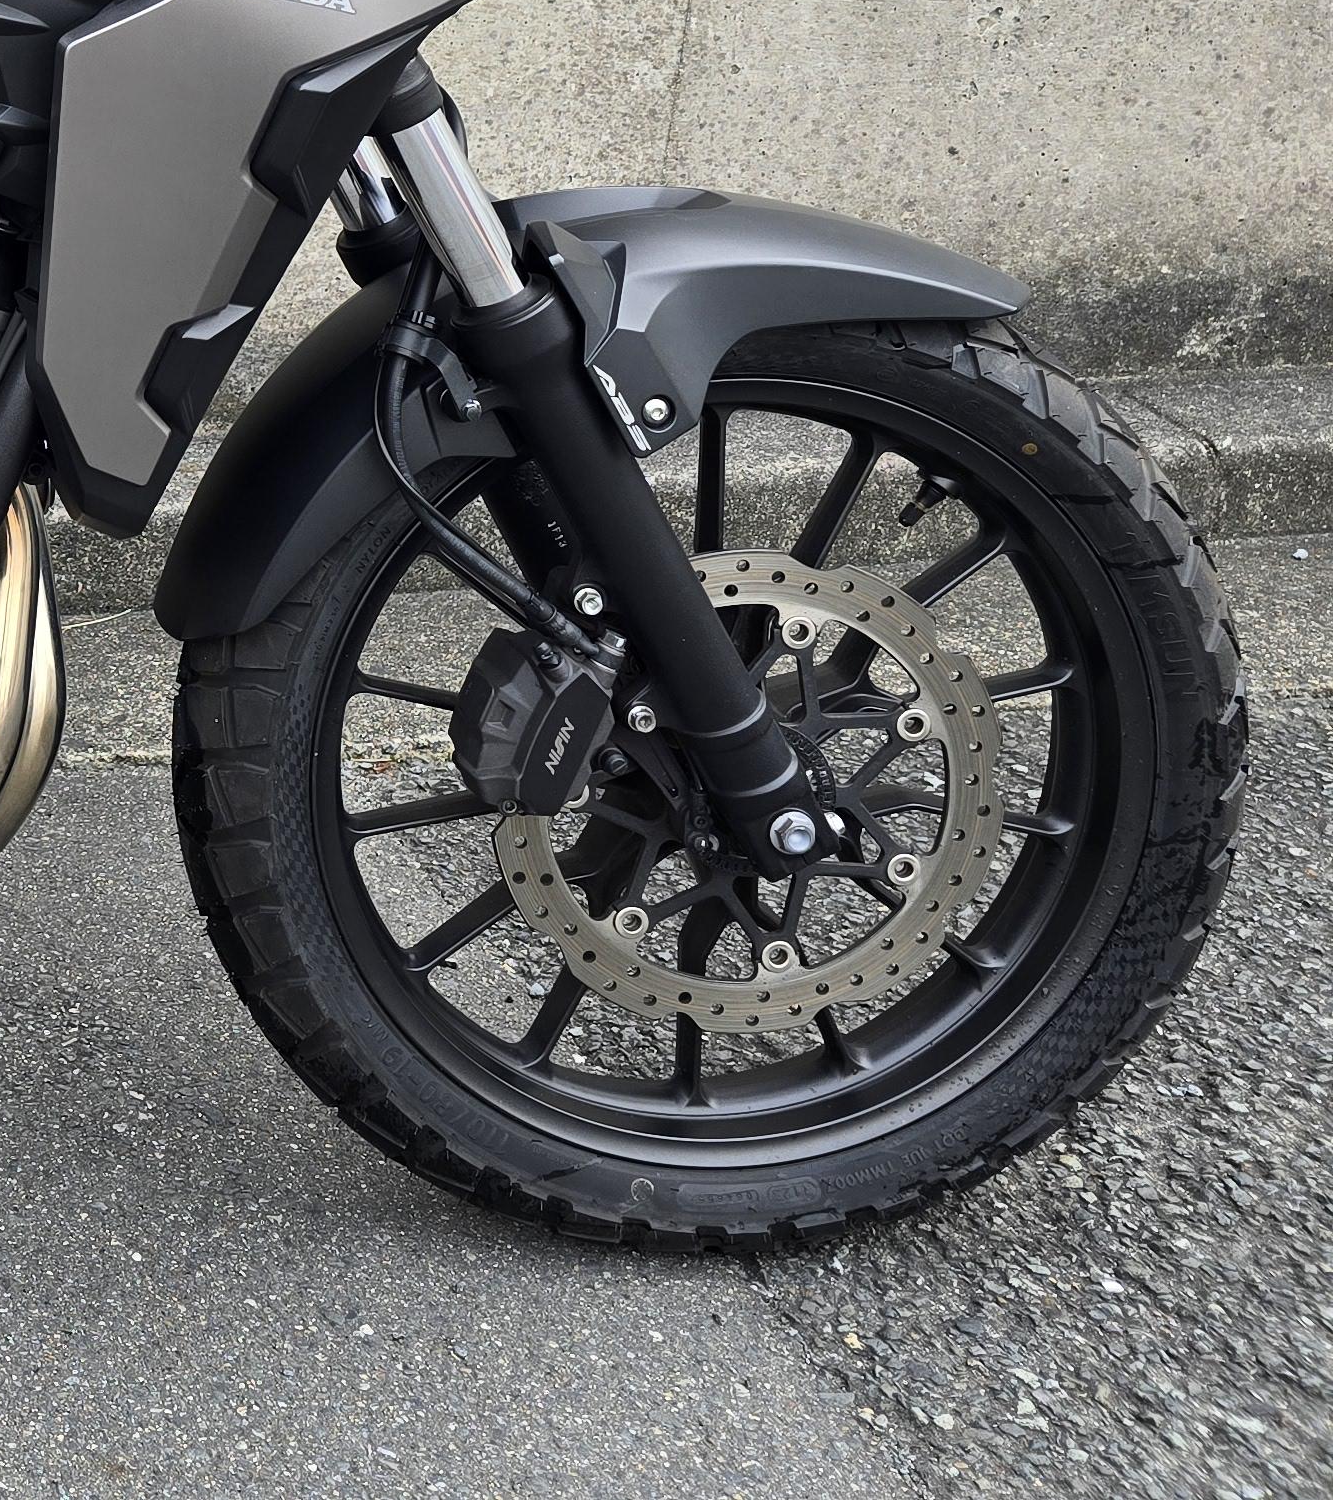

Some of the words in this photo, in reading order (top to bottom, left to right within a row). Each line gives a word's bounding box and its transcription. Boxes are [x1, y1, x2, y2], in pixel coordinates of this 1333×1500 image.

[591, 364, 652, 452] ABS
[355, 525, 392, 576] NYLON
[544, 716, 575, 776] NISSIN
[932, 1128, 966, 1154] DOT
